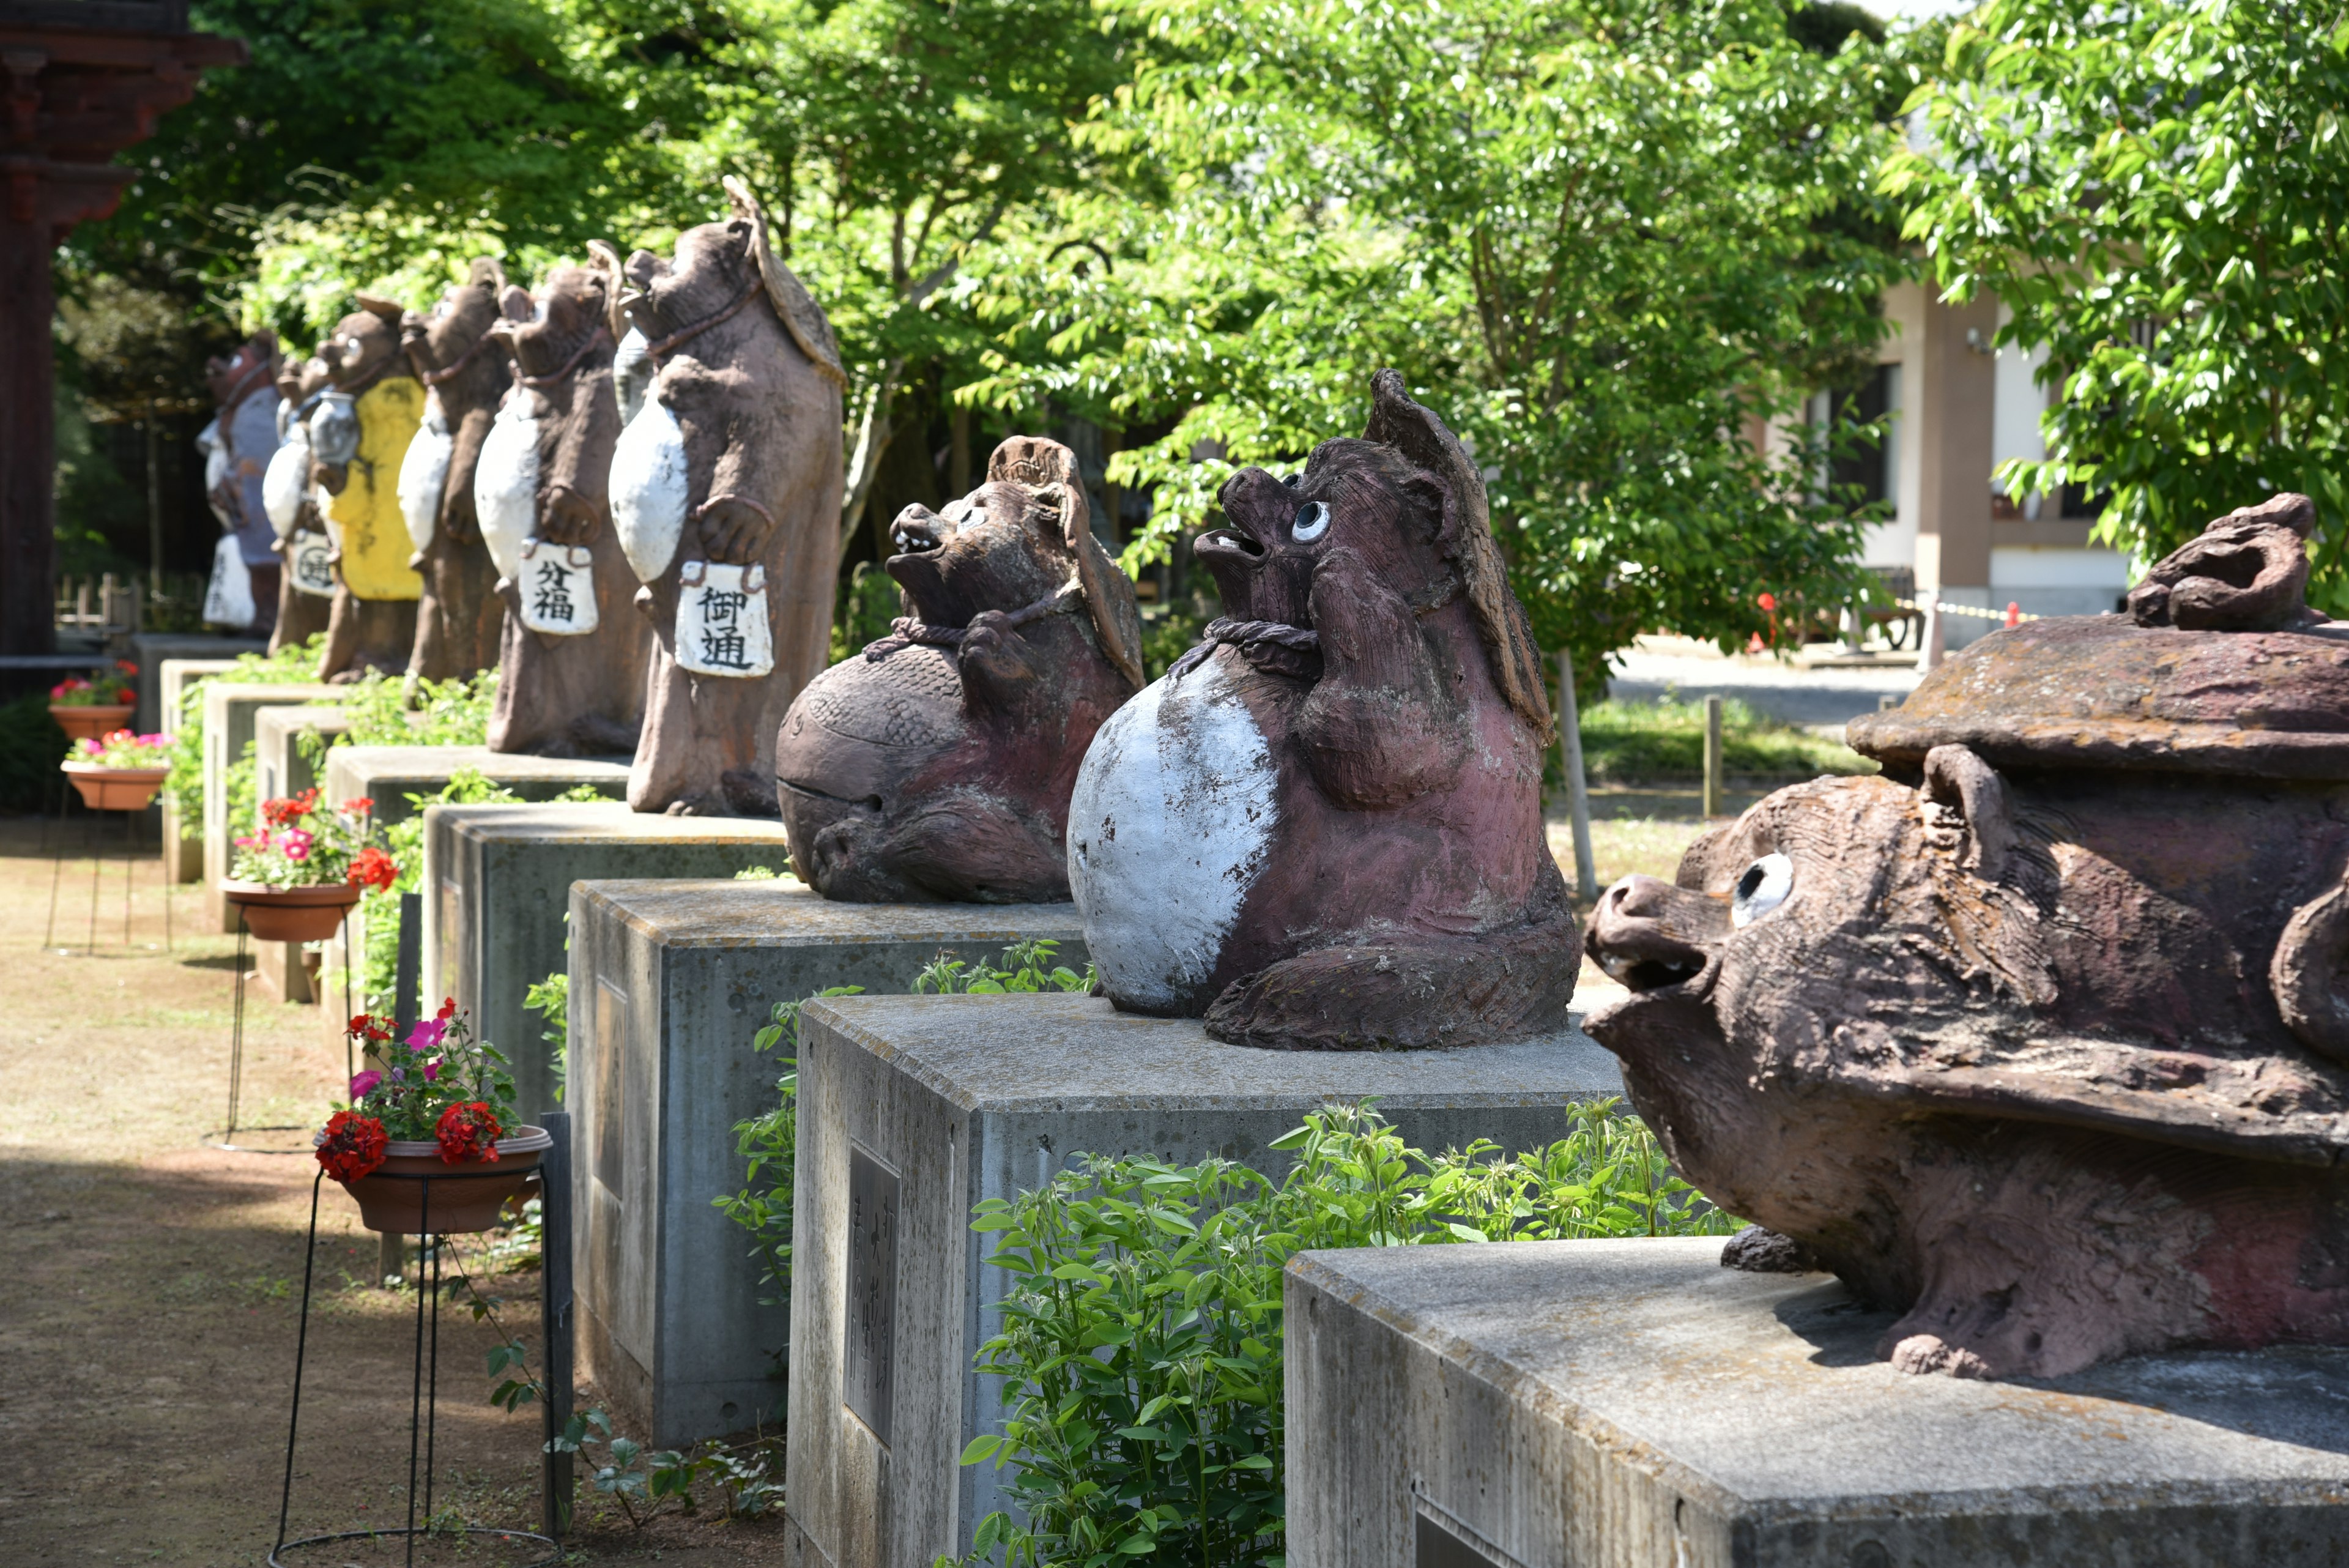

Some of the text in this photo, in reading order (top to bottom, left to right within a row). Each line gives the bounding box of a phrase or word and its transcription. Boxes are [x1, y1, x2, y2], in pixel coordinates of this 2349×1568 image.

[534, 559, 574, 623] 分福
[697, 586, 755, 670] 御通
[850, 1195, 866, 1381] 春の月
